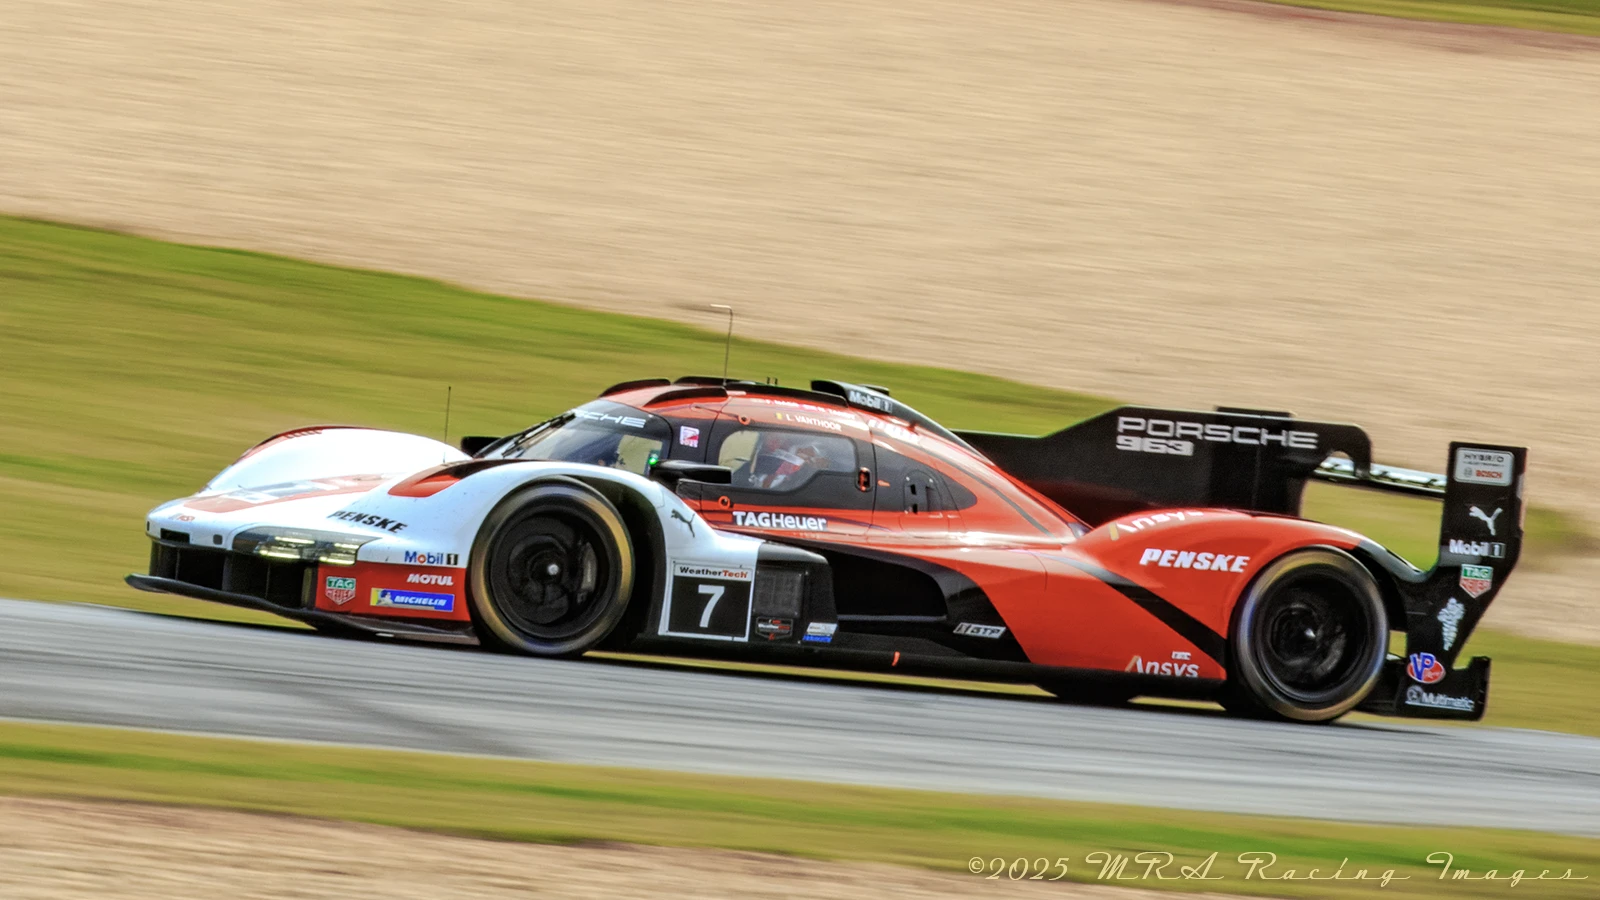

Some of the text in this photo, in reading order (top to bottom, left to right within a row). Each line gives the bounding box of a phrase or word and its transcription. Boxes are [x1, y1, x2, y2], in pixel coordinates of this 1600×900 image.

[849, 390, 882, 411] Mobil
[795, 415, 843, 432] VANTHOOR
[1117, 416, 1319, 449] PORSCHE
[1115, 435, 1194, 456] 963
[1475, 470, 1503, 478] BOSCH
[327, 511, 408, 534] PENSKE
[1449, 539, 1489, 557] Mobil
[404, 551, 444, 565] Mobil
[1139, 548, 1250, 573] PENSKE
[407, 573, 454, 586] MOTUL
[680, 566, 748, 579] WeatherTech
[1463, 567, 1490, 579] TAG
[328, 579, 355, 590] TAG
[394, 596, 447, 606] MICHELIN
[698, 584, 725, 628] 7
[1125, 655, 1200, 678] Ansys
[1409, 651, 1436, 682] VP
